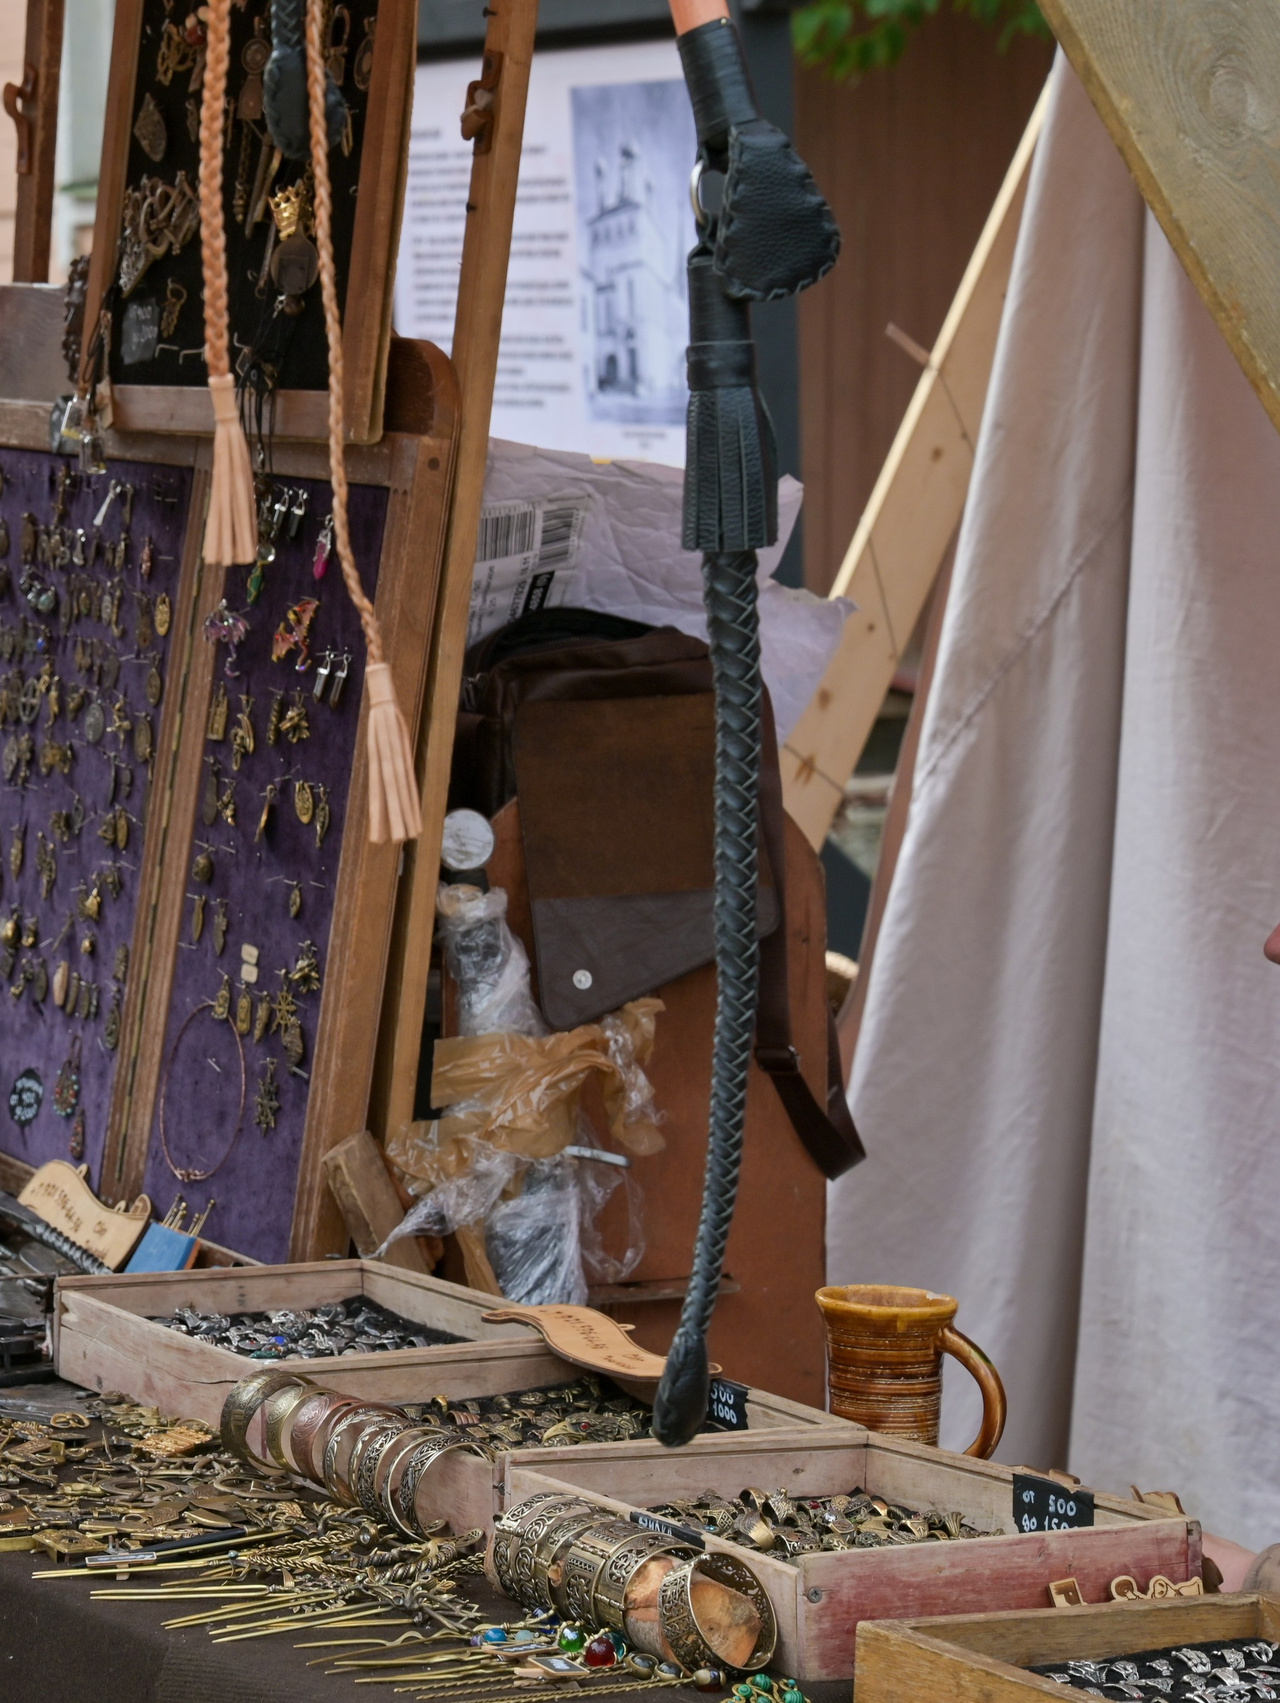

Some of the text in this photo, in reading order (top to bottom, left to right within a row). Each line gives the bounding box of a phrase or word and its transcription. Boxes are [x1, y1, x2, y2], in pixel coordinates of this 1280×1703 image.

[711, 1382, 734, 1405] 500
[713, 1401, 738, 1424] 1000
[1022, 1490, 1076, 1517] от 500
[1044, 1515, 1079, 1531] 150
